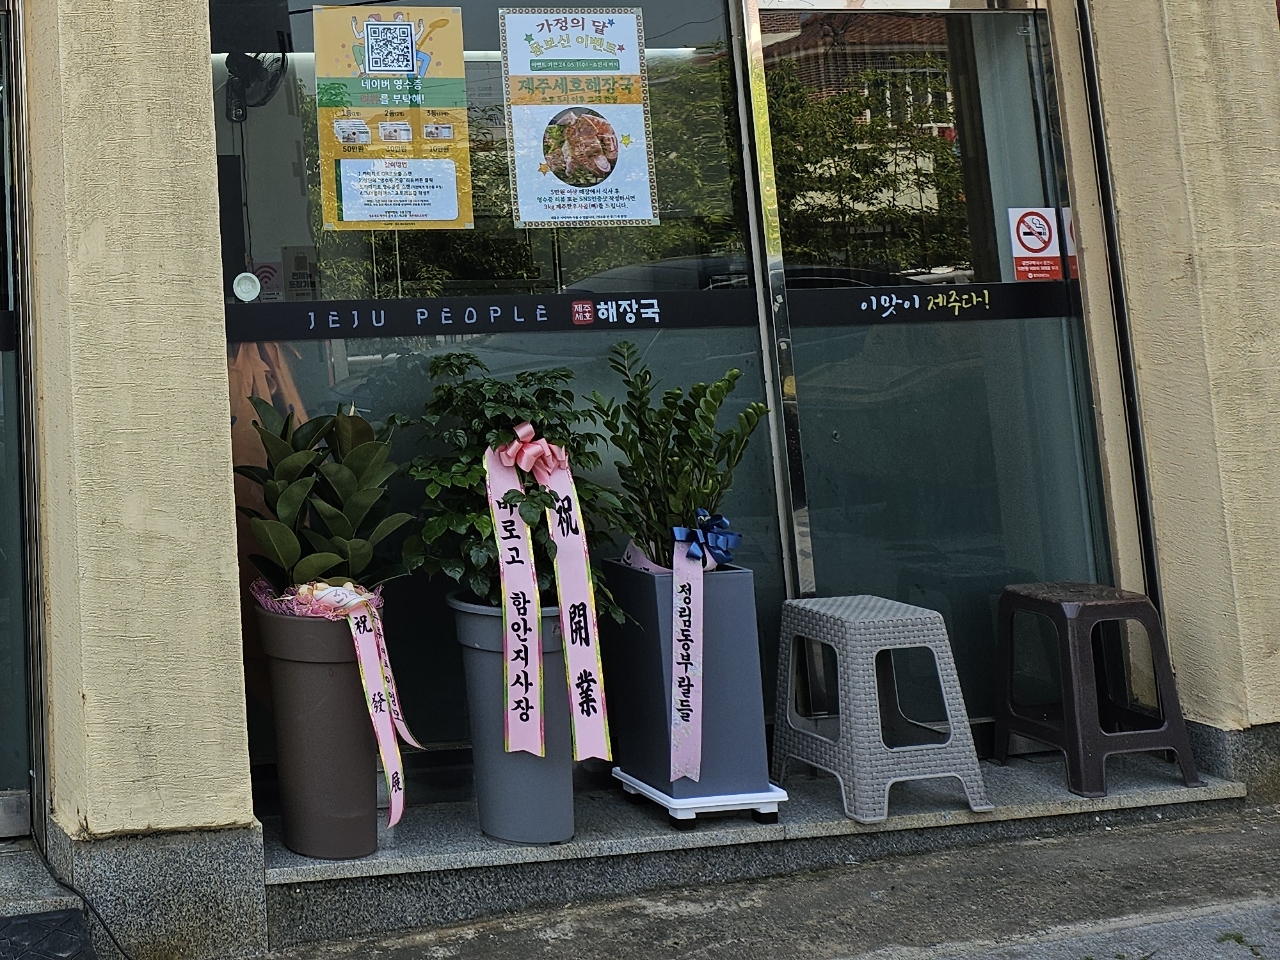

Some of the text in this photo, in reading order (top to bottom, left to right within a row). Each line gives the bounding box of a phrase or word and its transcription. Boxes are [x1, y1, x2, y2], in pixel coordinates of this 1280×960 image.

[536, 17, 609, 35] 가정의 달
[575, 34, 618, 55] 이벤트
[361, 78, 423, 91] 네이버 영수증
[517, 76, 635, 95] 제주세호해장국
[392, 93, 426, 104] 부탁해!
[573, 303, 592, 312] 제주
[596, 299, 661, 324] 해장국
[861, 289, 991, 317] 이맛이 제주다!
[308, 305, 548, 331] JEJU PEOPLE
[574, 313, 593, 321] 세호
[496, 498, 535, 723] 바로고 함안지사장
